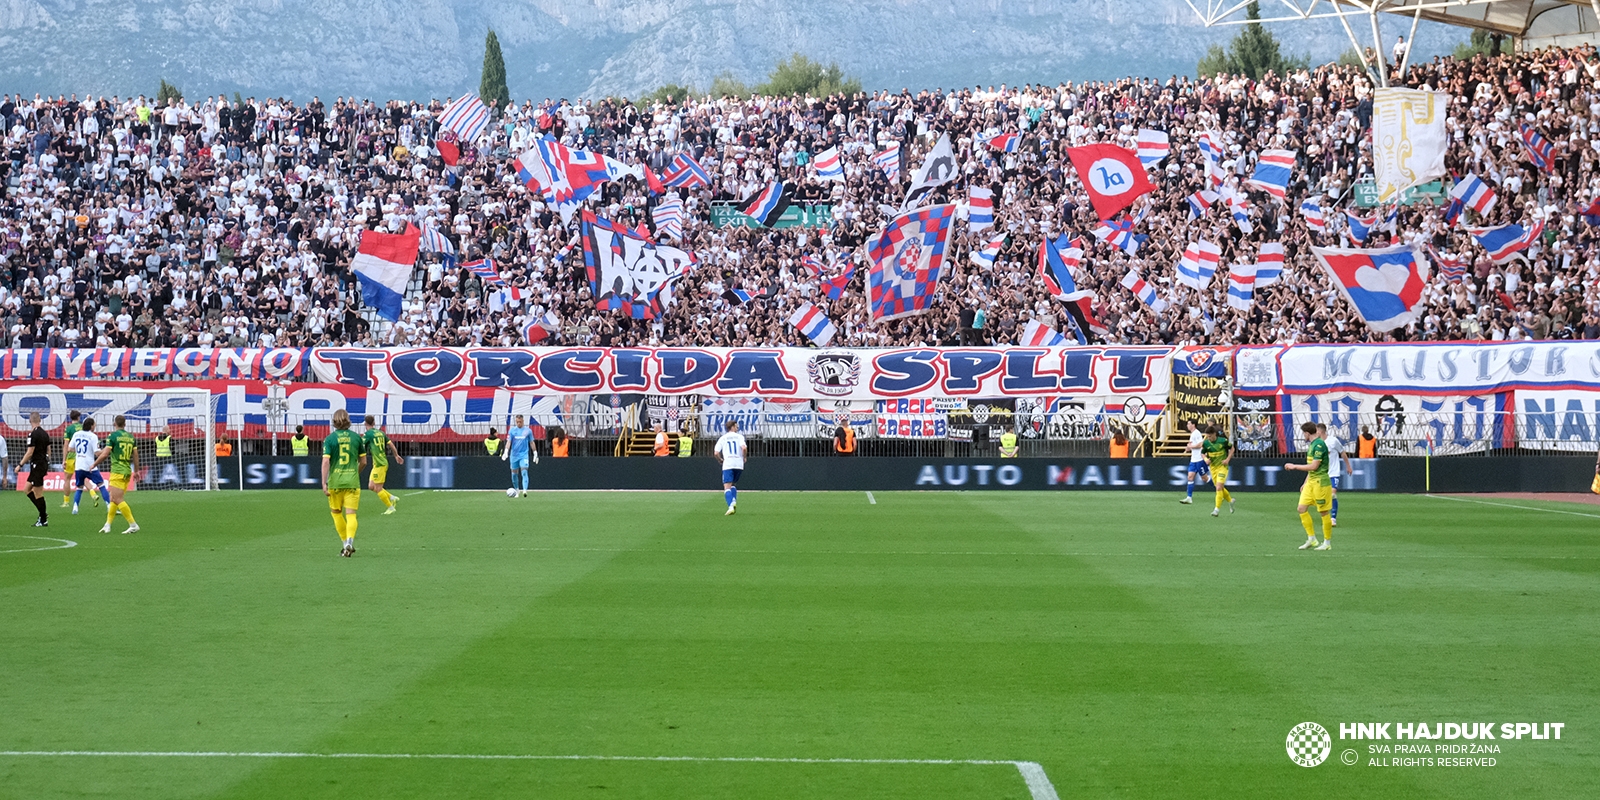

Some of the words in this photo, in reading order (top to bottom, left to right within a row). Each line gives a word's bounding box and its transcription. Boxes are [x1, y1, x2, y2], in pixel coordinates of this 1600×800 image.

[719, 217, 747, 225] EXIT
[315, 346, 798, 394] TORCIDA
[870, 346, 1176, 395] SPLIT
[226, 384, 564, 434] HAJDUK
[877, 418, 946, 436] ZAGREB
[1524, 398, 1600, 441] NA
[76, 438, 89, 454] 23
[119, 442, 133, 460] 30
[373, 436, 385, 451] 44
[727, 441, 737, 455] 11
[339, 444, 350, 465] 5
[246, 463, 318, 484] SPL
[915, 464, 1023, 485] AUTO
[1047, 464, 1152, 485] MALL
[1169, 465, 1282, 486] SLIT
